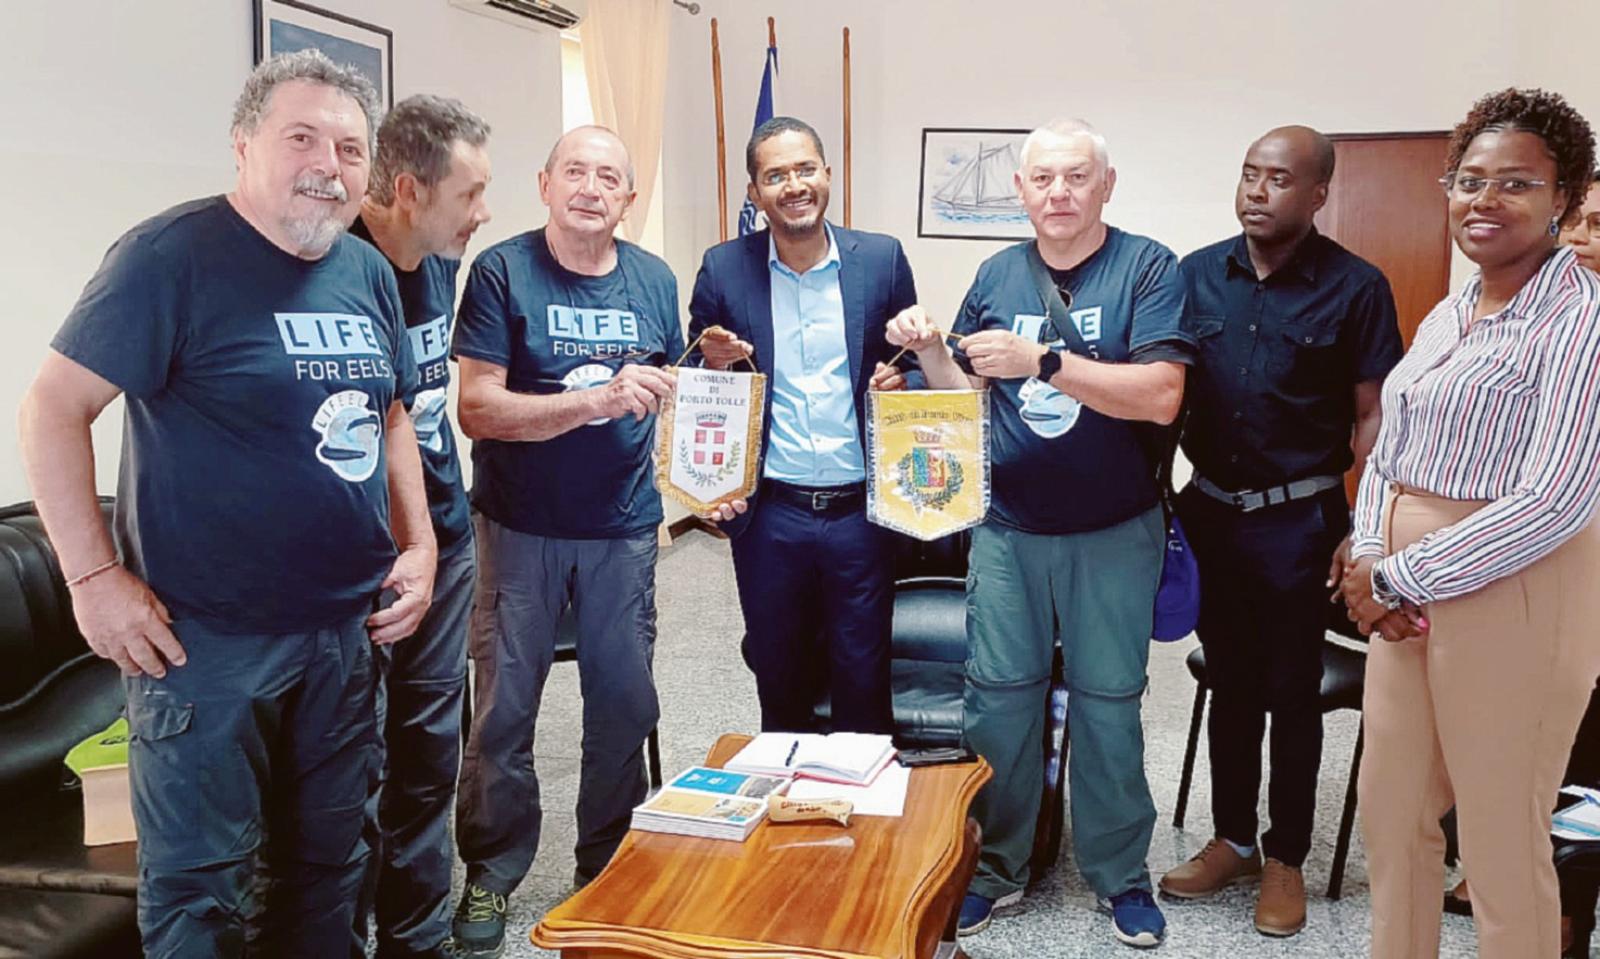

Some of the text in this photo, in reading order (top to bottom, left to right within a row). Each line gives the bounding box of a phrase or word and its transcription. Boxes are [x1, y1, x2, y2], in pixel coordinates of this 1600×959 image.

[553, 309, 634, 336] LIFE
[284, 319, 378, 348] LIFE
[553, 340, 592, 356] FOR
[295, 359, 391, 380] FOR EELS
[694, 374, 736, 385] COMUNE
[709, 386, 720, 394] DI
[680, 394, 747, 407] PORTO TOLLE
